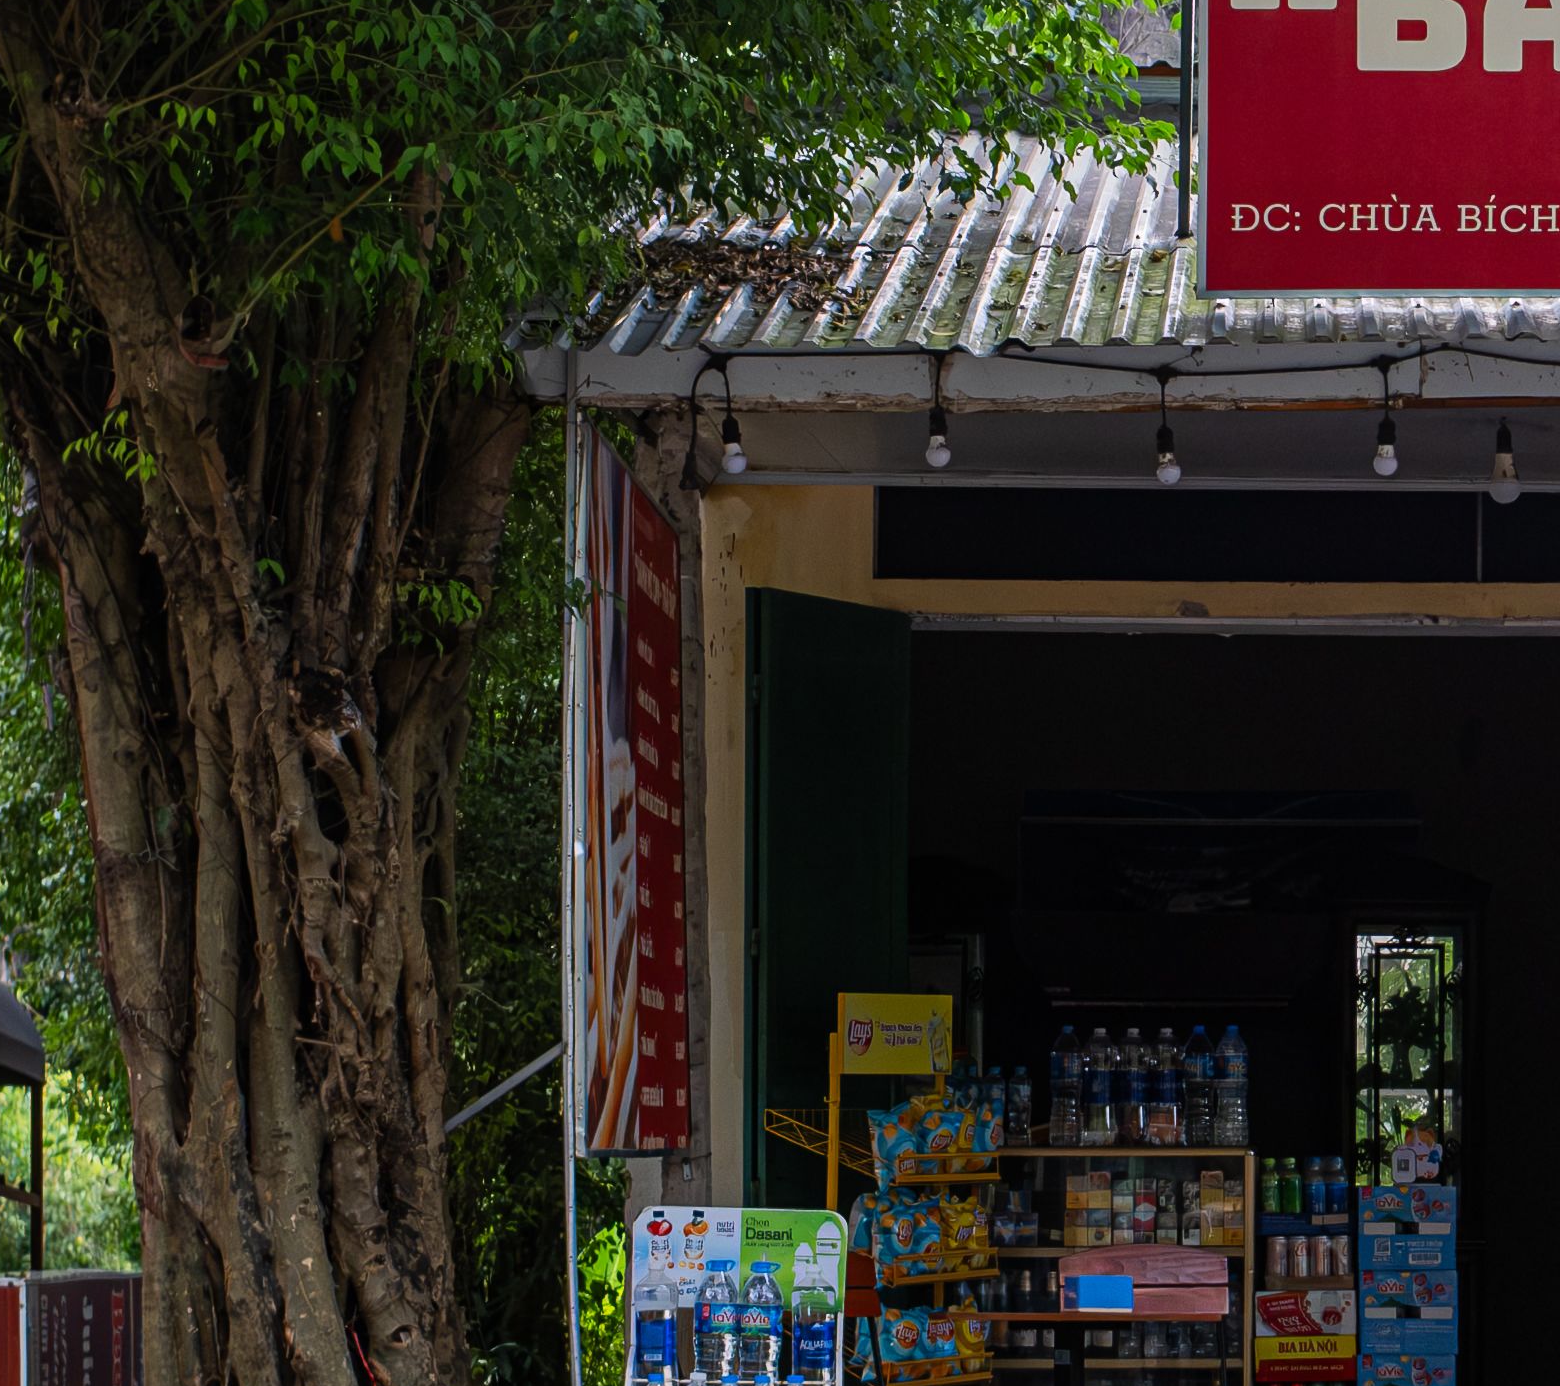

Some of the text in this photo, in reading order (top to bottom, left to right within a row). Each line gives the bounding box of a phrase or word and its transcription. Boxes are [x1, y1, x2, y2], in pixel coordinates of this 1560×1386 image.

[1231, 203, 1301, 232] ĐC:
[1319, 194, 1441, 232] CHÙA
[1457, 194, 1560, 233] BÍCH
[745, 1227, 793, 1241] Dasani
[1278, 1338, 1337, 1355] BIA HÀ NỘI
